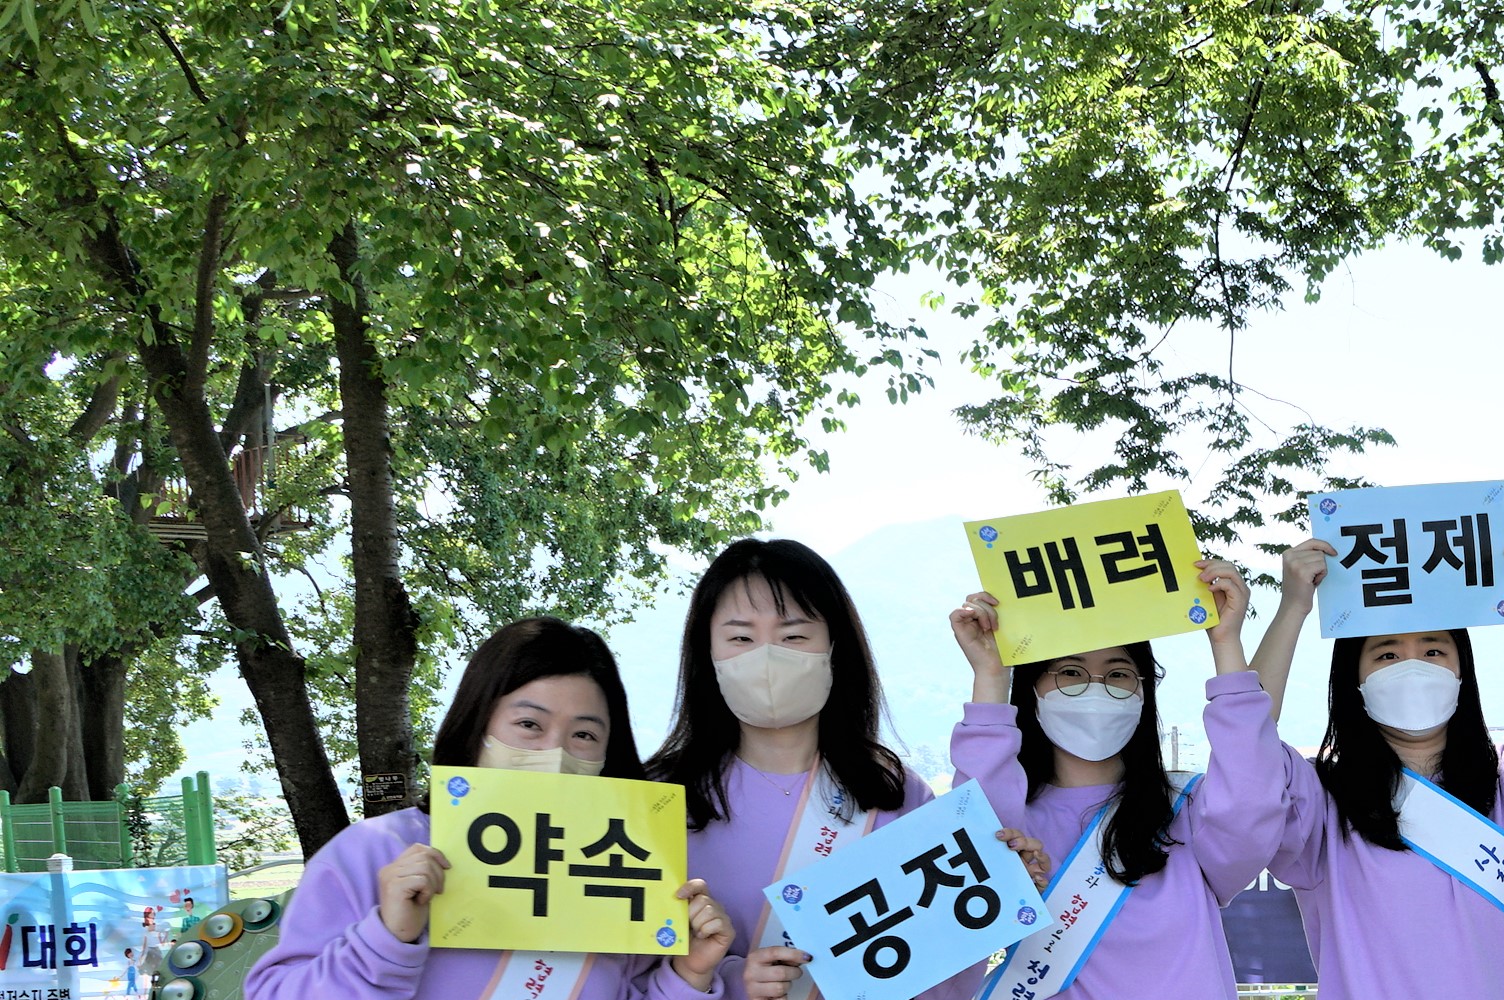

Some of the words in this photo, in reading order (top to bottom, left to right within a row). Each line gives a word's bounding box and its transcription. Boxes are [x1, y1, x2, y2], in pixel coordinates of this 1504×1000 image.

[1004, 523, 1179, 610] 배려
[1340, 513, 1494, 607] 절제
[467, 812, 662, 922] 약속
[824, 827, 1001, 979] 공정
[21, 923, 98, 969] 대회
[1044, 894, 1088, 953] 협력으로
